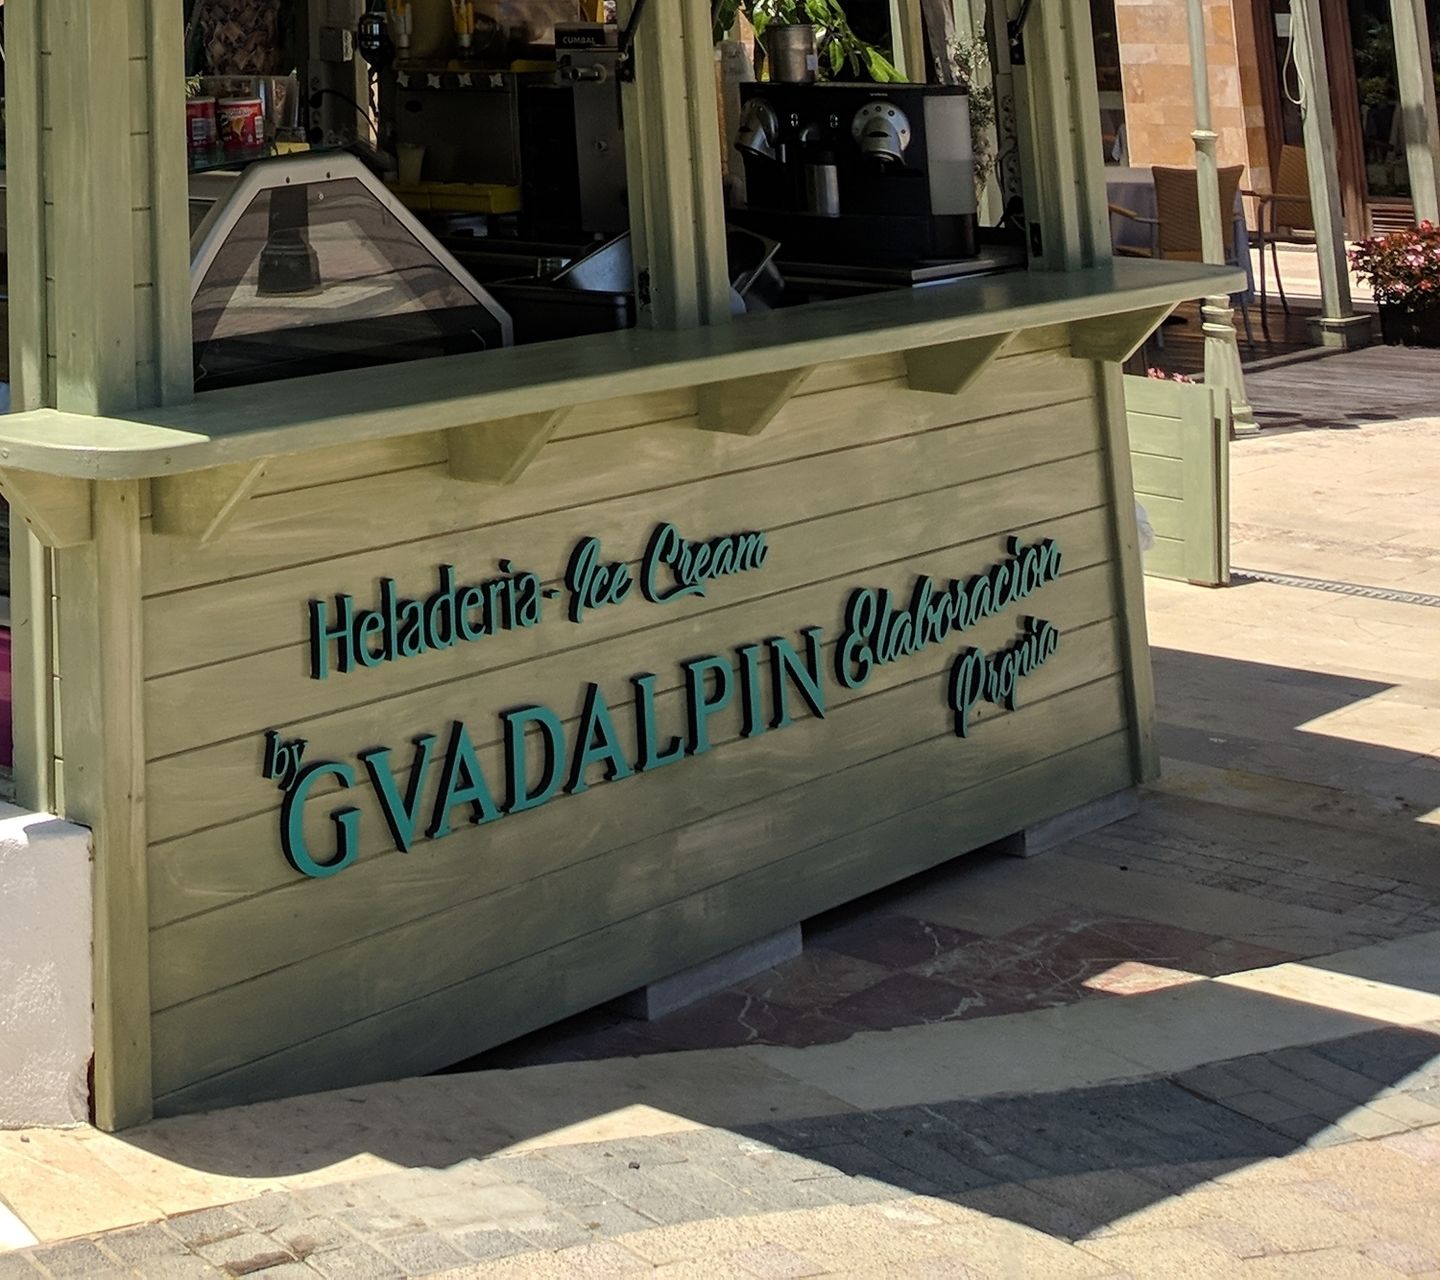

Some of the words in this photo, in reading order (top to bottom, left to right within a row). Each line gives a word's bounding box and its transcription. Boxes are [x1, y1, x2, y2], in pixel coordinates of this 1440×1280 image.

[567, 536, 633, 624] Ice
[640, 522, 769, 604] Cream
[835, 535, 1062, 689] Elaboracion
[948, 615, 1059, 739] Propia
[263, 731, 308, 791] by
[279, 626, 826, 879] GVADALPIN
